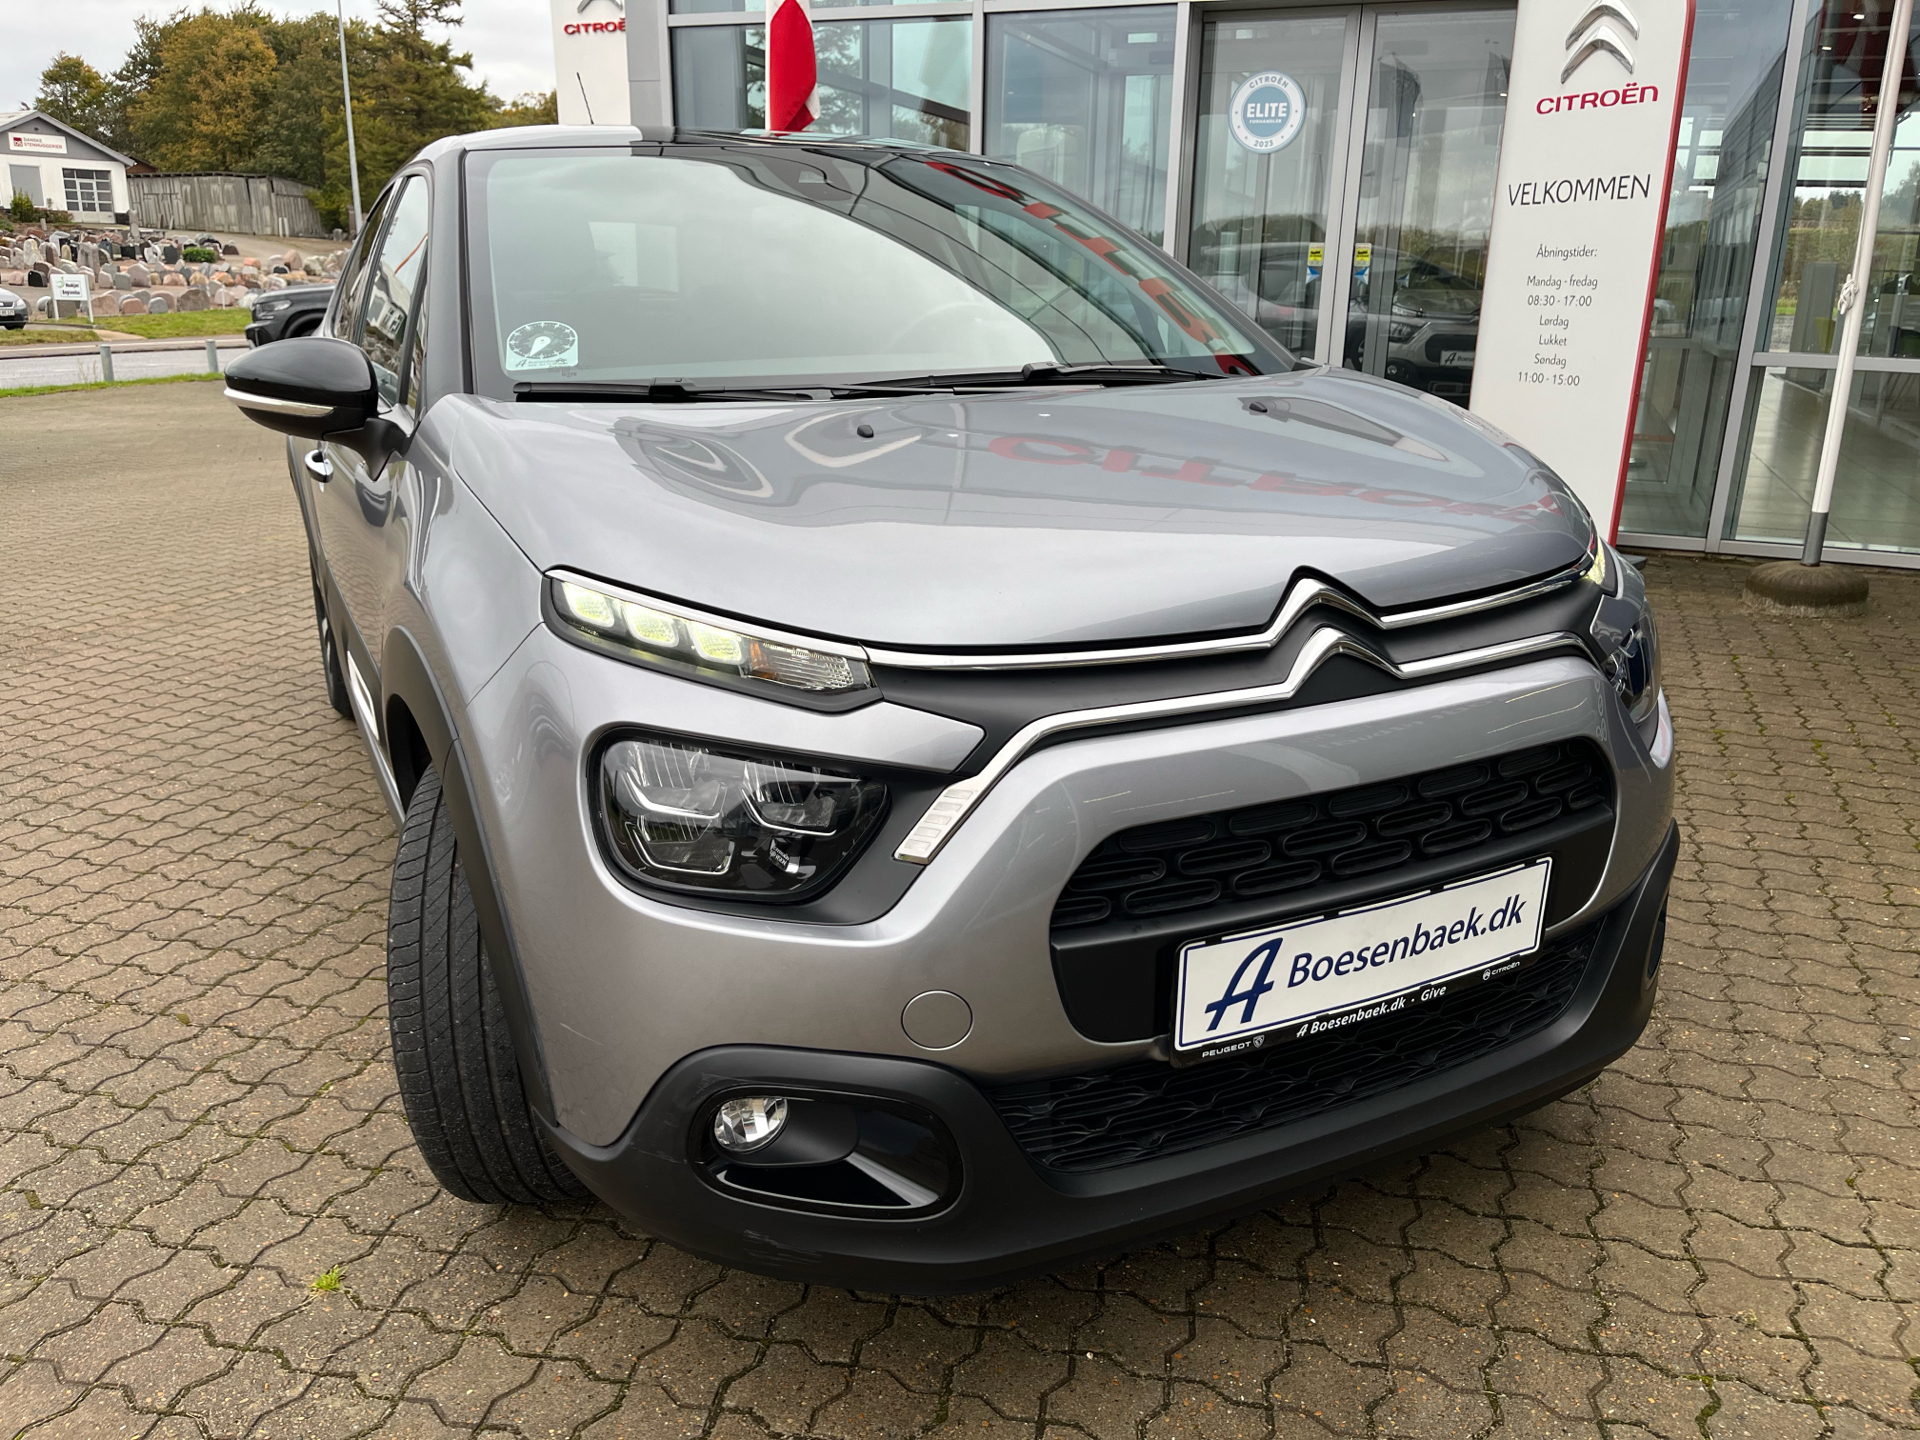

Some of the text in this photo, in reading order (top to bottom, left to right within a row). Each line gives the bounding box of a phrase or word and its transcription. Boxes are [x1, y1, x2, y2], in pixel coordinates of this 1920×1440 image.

[563, 17, 626, 35] CITROË
[1249, 76, 1289, 89] CITROËN
[1246, 102, 1288, 118] ELITE
[1253, 140, 1274, 148] 2023
[1508, 174, 1651, 206] VELKOMMEN
[1536, 243, 1598, 261] Åbningstider:
[1526, 275, 1562, 290] Mandag
[1569, 274, 1598, 290] fredag
[1527, 294, 1556, 306] 08:30
[1564, 294, 1593, 307] 17:00
[1539, 314, 1570, 330] Lørdag
[1538, 333, 1567, 346] Lukket
[1533, 353, 1567, 369] Søndag
[1518, 371, 1545, 383] 11:00
[1553, 373, 1580, 386] 15:00
[1204, 894, 1528, 1032] A Boesenbaek.dk
[1310, 997, 1406, 1034] Boesenbaek.dk
[1420, 985, 1447, 1001] Give
[1202, 1041, 1252, 1058] PEUGEOT
